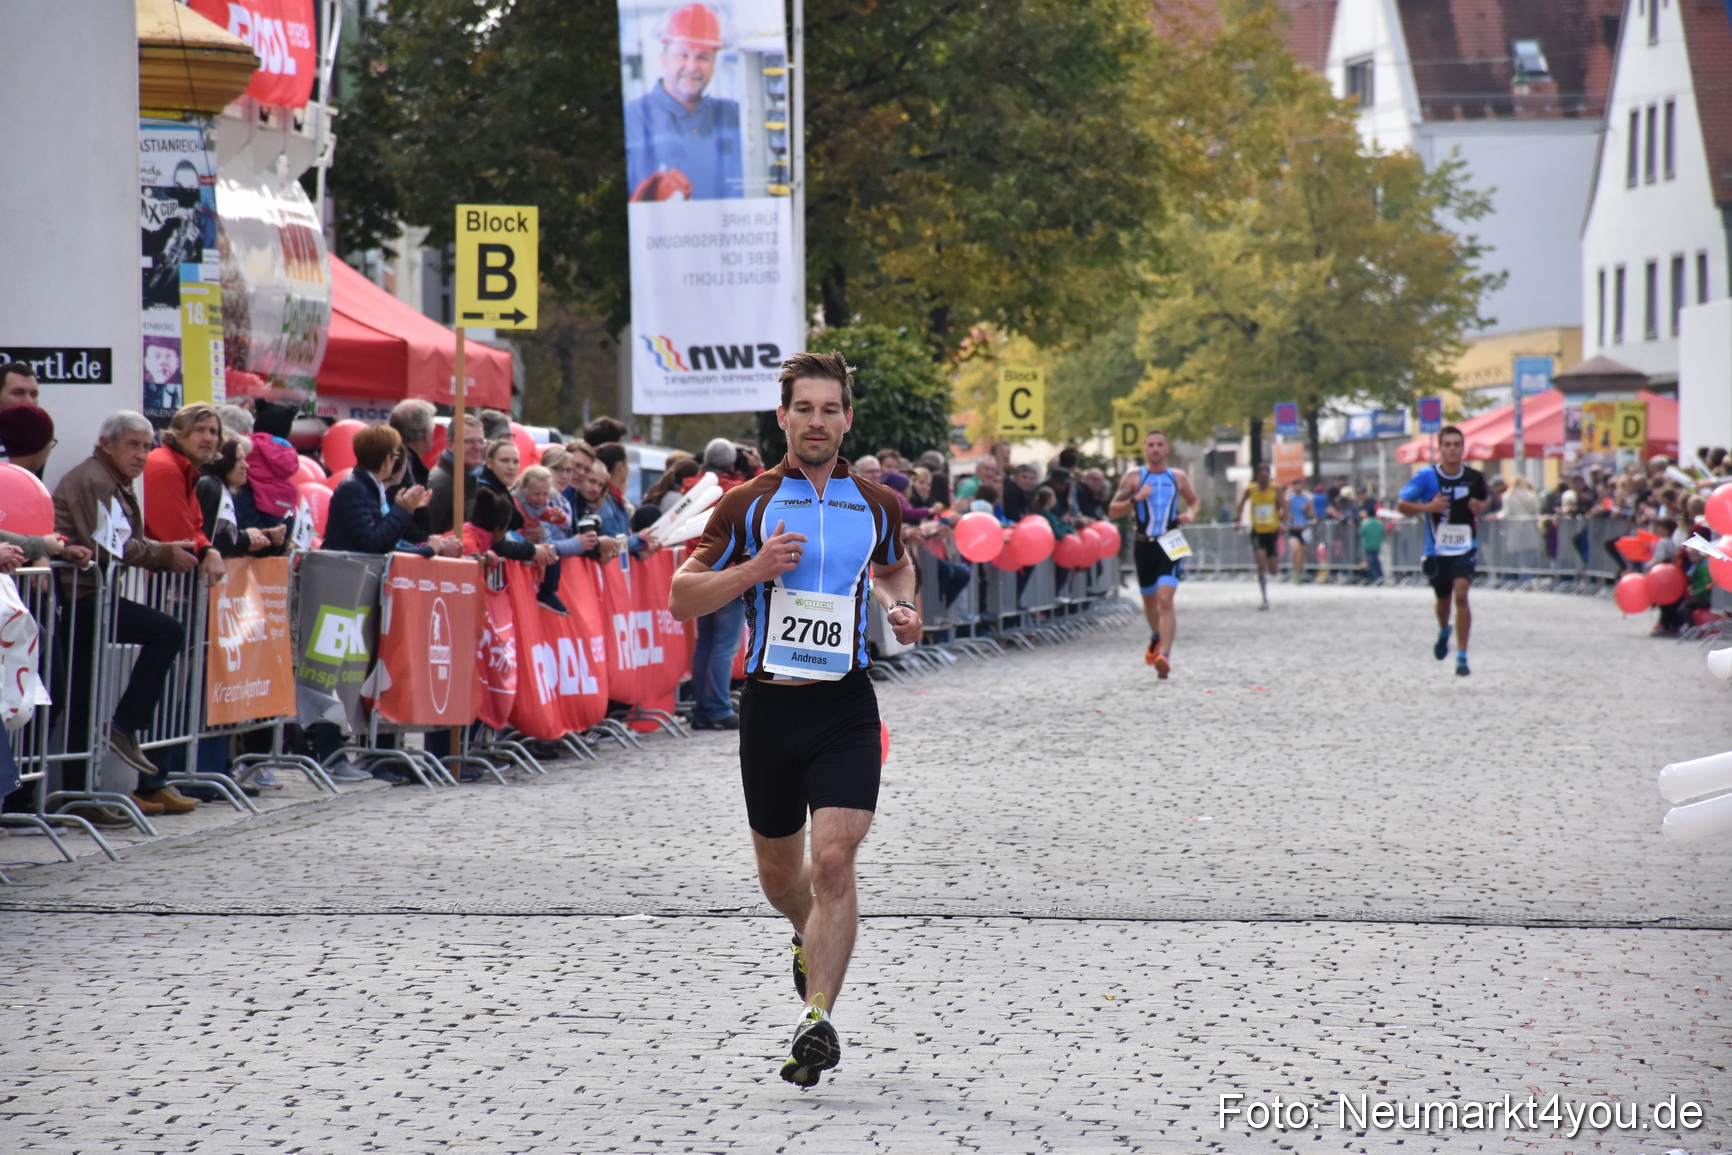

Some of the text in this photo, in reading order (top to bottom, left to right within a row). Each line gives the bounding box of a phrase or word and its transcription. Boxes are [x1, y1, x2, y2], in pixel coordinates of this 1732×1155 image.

[160, 202, 177, 216] CUP
[466, 210, 528, 233] Block
[477, 243, 517, 301] B
[1004, 369, 1038, 382] Block
[1010, 387, 1032, 420] C
[1122, 423, 1139, 446] D
[1623, 415, 1640, 438] D
[804, 599, 834, 611] BOCK
[780, 615, 842, 648] 2708
[791, 651, 828, 666] Andreas
